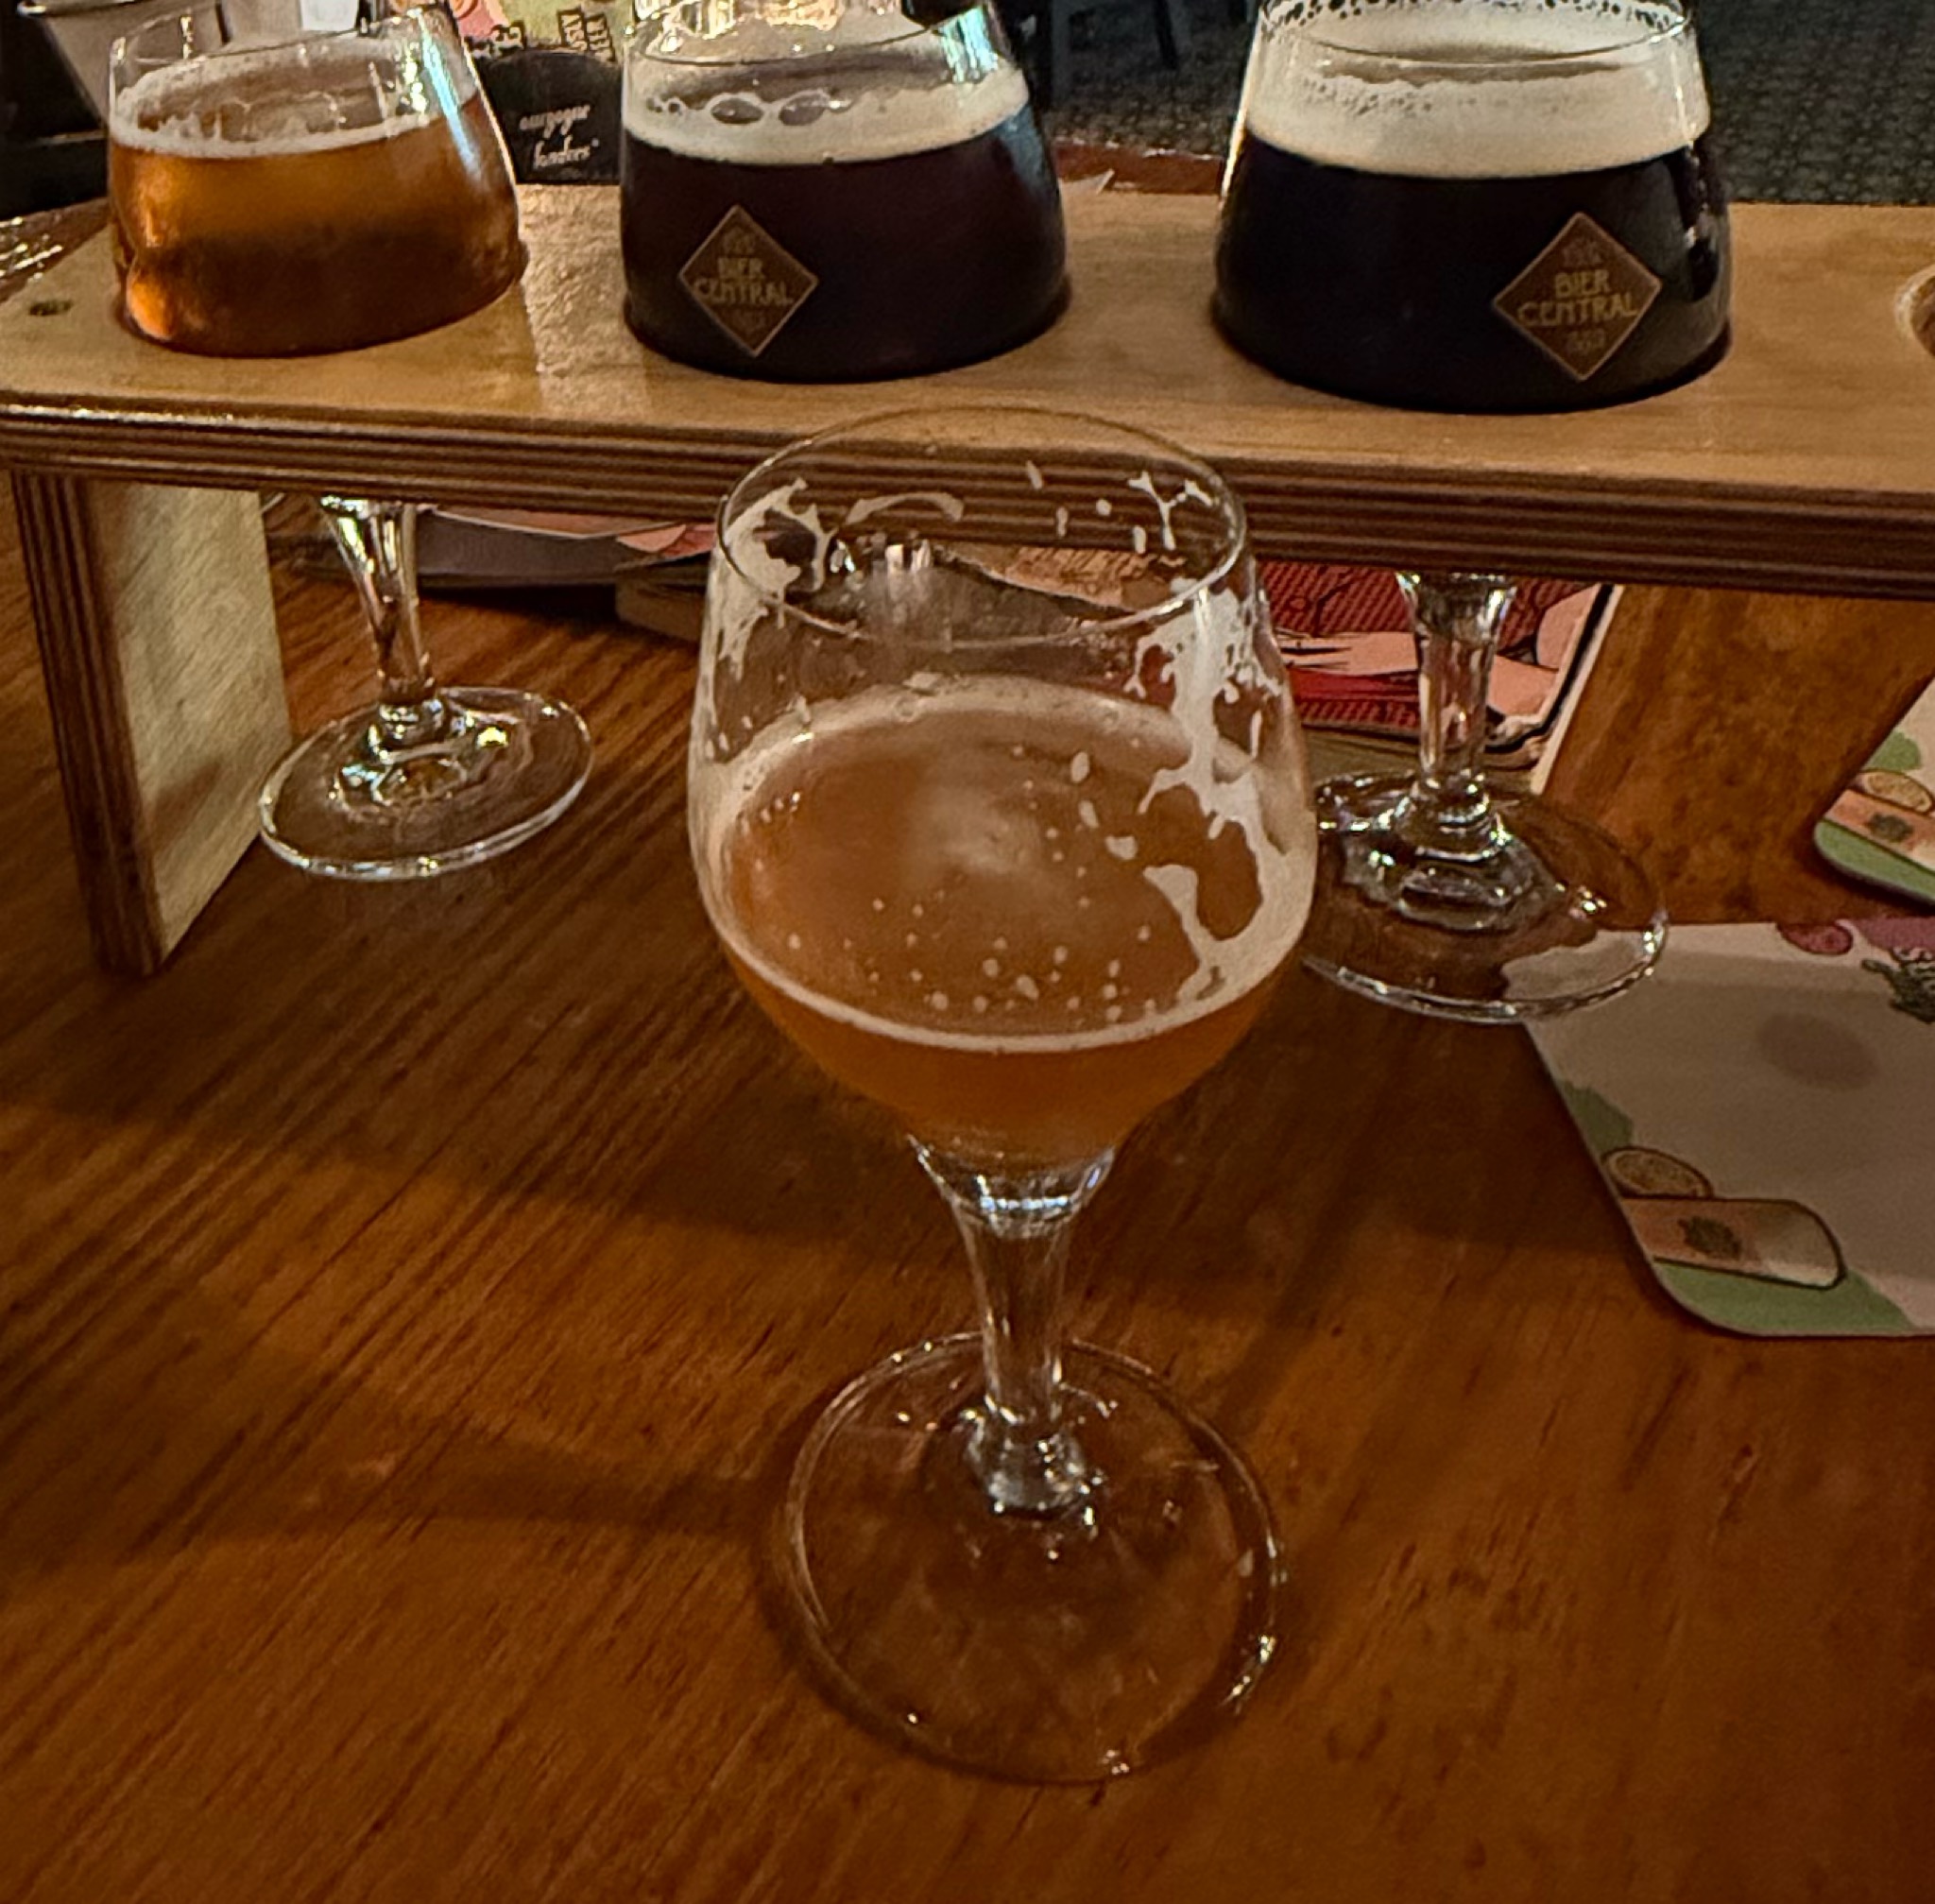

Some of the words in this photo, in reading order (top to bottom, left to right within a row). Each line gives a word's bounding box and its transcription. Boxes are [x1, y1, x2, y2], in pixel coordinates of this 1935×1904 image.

[717, 256, 765, 280] BIER
[693, 278, 795, 306] CENTRAL
[1555, 268, 1610, 299] BIER
[1516, 292, 1639, 327] CENTRAL
